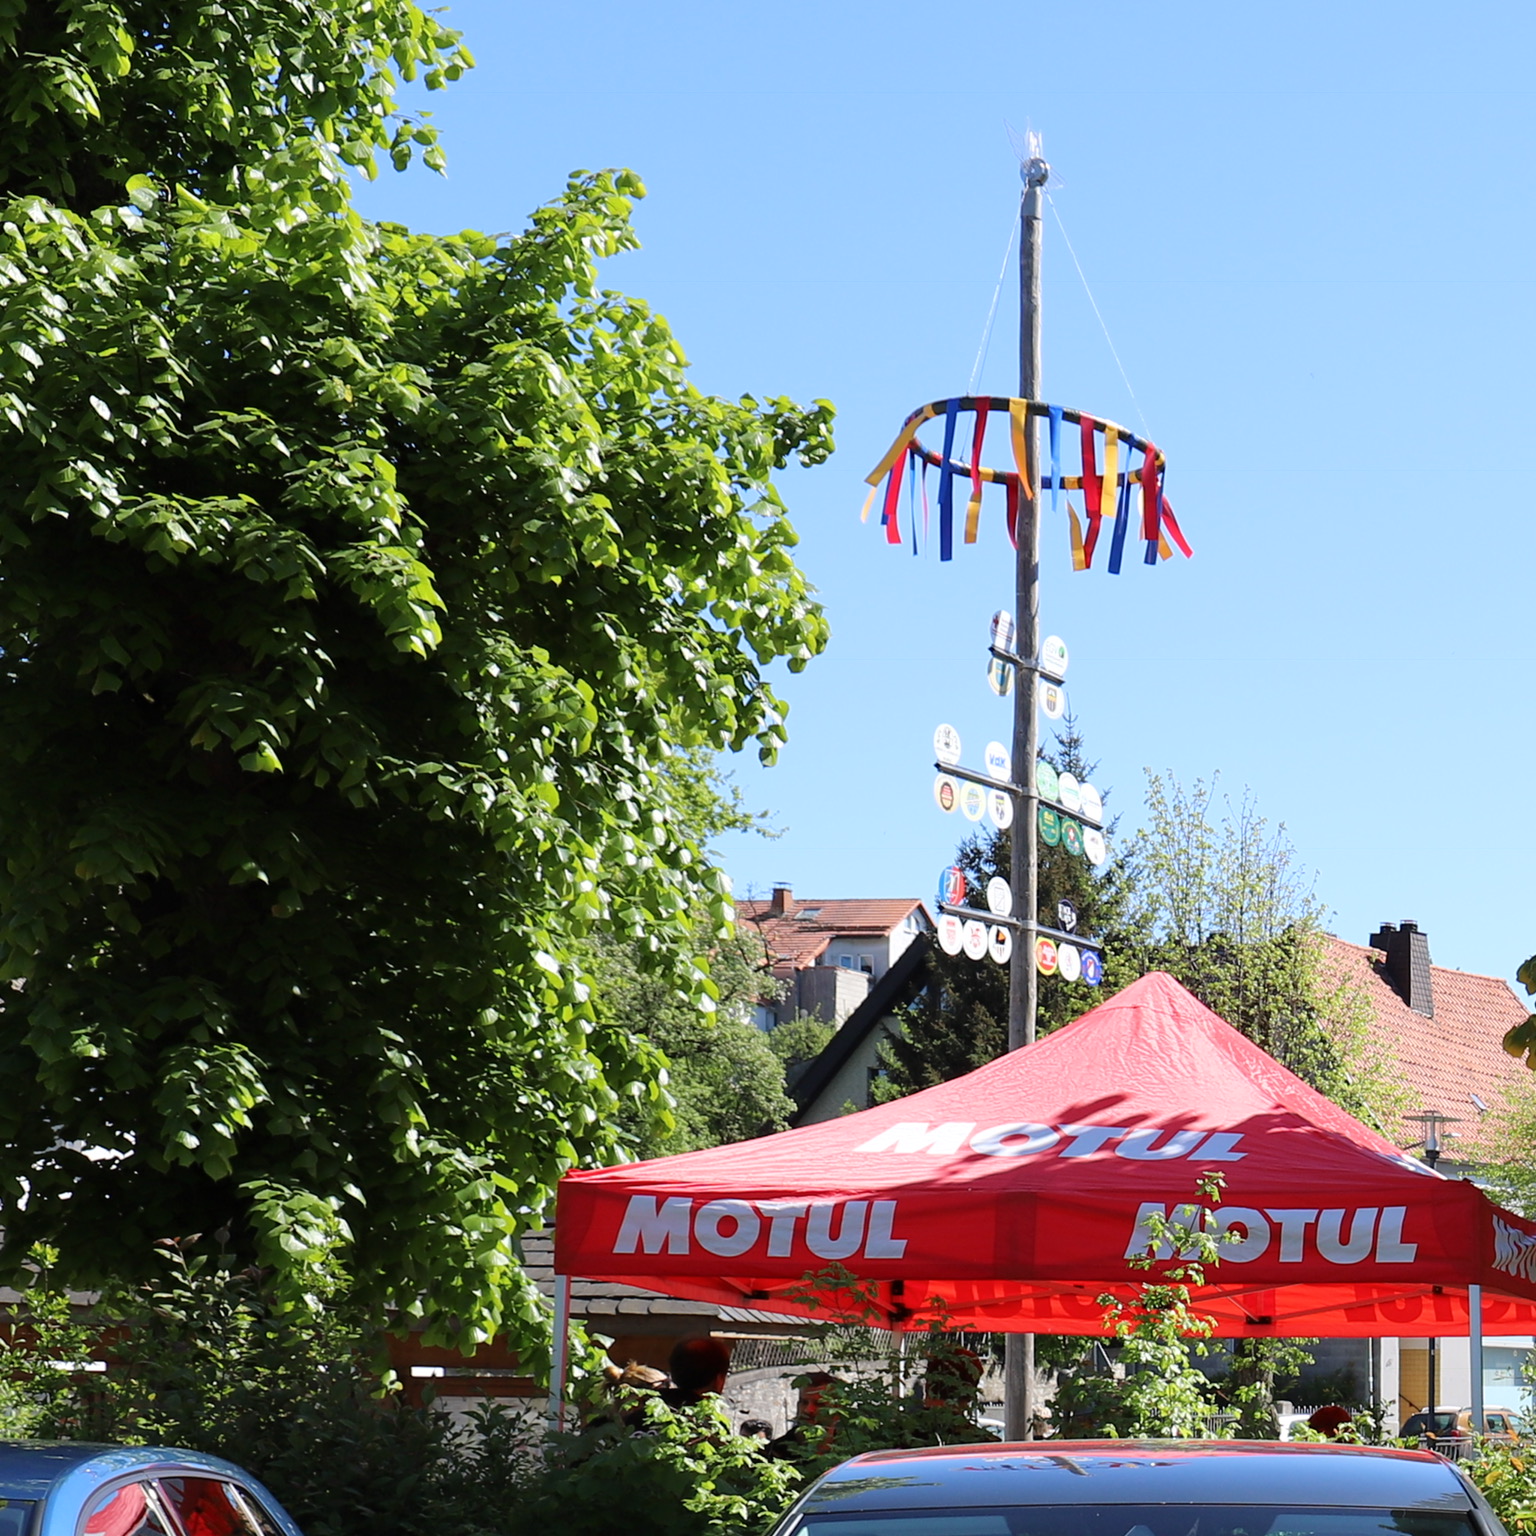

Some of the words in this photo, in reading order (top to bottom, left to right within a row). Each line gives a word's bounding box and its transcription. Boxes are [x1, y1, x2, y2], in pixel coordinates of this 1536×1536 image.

[852, 1122, 1247, 1161] MOTUL
[613, 1194, 908, 1260] MOTUL
[1123, 1202, 1419, 1265] MOTUL
